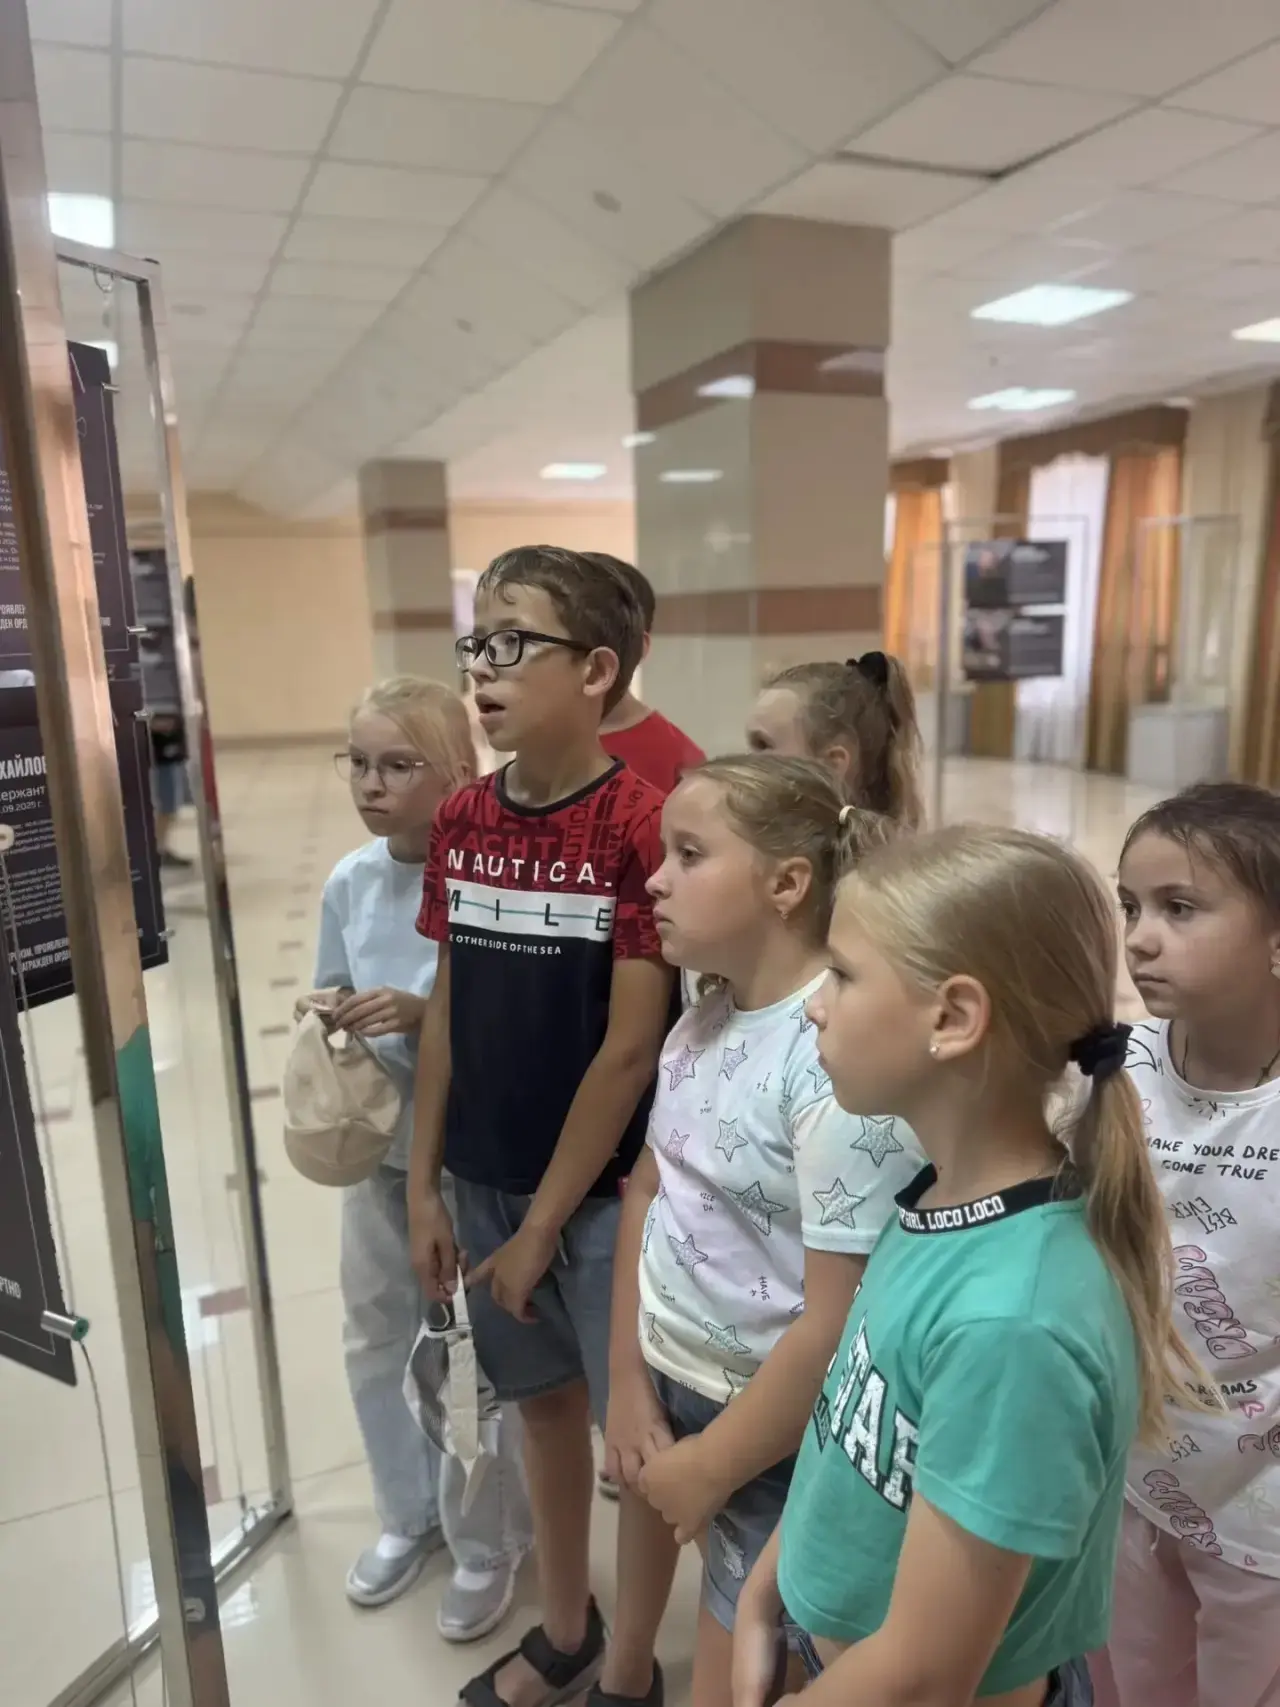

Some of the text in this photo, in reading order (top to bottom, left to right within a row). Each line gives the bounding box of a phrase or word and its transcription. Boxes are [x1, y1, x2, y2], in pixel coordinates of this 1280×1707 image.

[447, 848, 612, 888] NAUTICA.
[540, 946, 561, 955] SEA
[1193, 1144, 1235, 1158] YOUR
[1242, 1145, 1280, 1162] DRE
[1161, 1159, 1268, 1181] COME TRUE
[926, 1208, 963, 1229] LOCO
[964, 1195, 1005, 1223] LOCO
[1197, 1208, 1238, 1234] BEST
